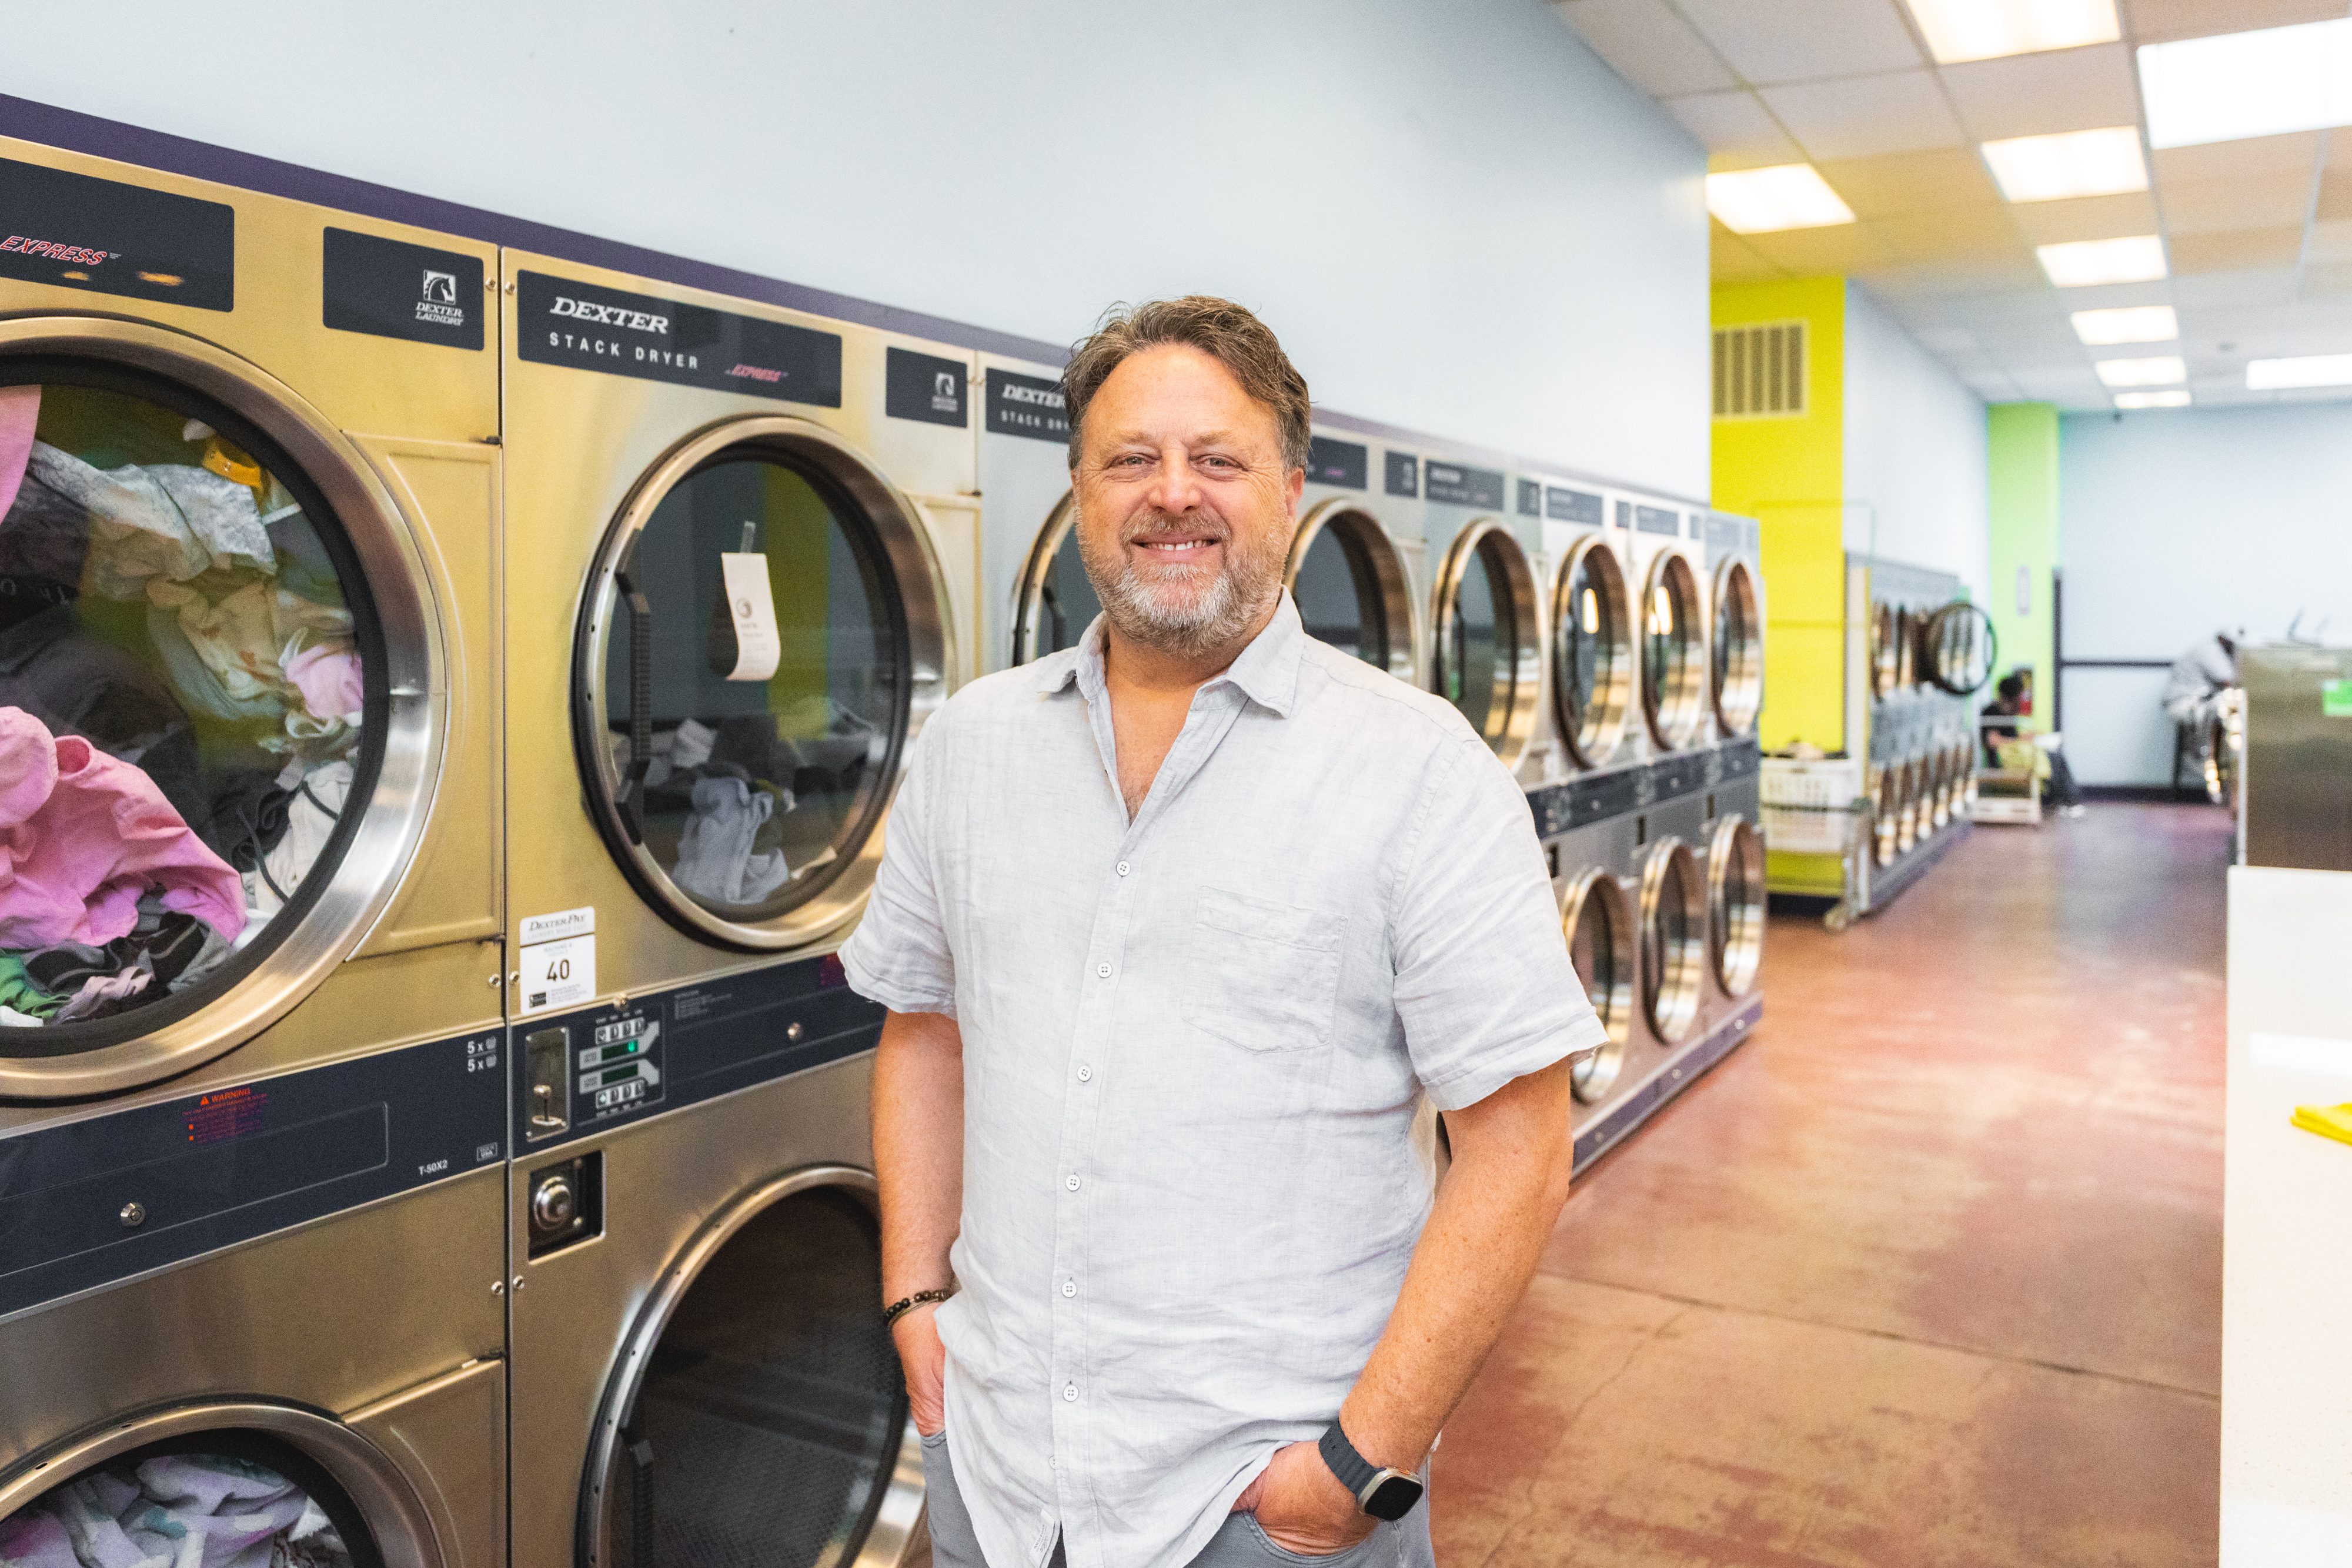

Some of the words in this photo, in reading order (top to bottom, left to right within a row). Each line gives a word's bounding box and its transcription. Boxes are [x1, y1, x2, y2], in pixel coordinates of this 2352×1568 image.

[0, 236, 107, 265] EXPRESS
[415, 301, 463, 318] DEXTER
[550, 296, 669, 335] DEXTER
[415, 311, 463, 326] LAUNDRY
[549, 332, 620, 357] STACK
[635, 346, 699, 370] DRYER
[547, 959, 570, 981] 40
[467, 1040, 475, 1054] 5
[467, 1058, 475, 1072] 5
[212, 1088, 251, 1103] WARNING
